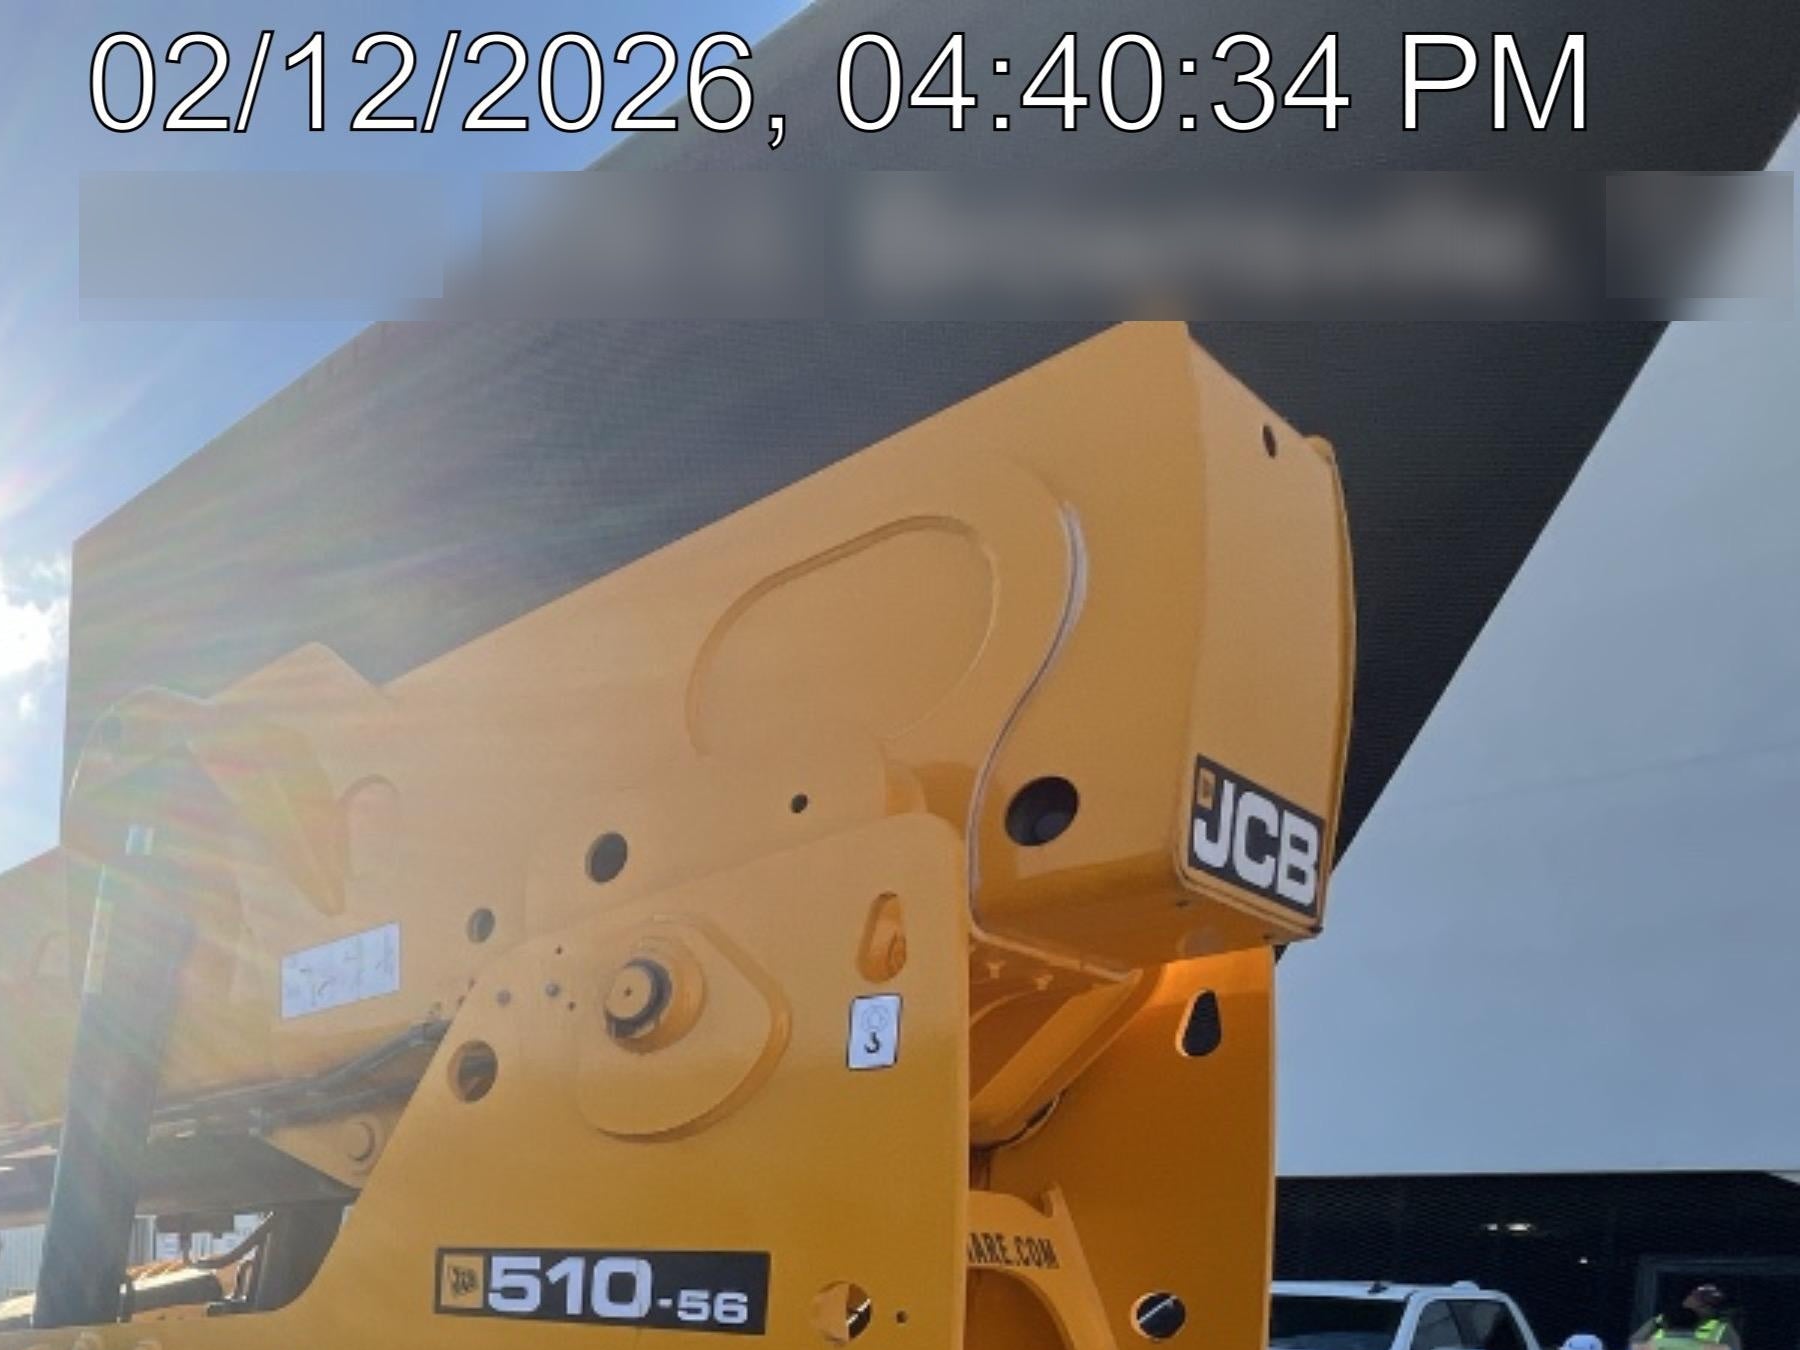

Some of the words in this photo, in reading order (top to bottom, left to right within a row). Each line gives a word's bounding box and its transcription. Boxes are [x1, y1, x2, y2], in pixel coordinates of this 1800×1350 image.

[1193, 779, 1319, 906] JCB
[966, 1231, 1060, 1269] ARE.COM
[488, 1255, 749, 1324] 510-56
